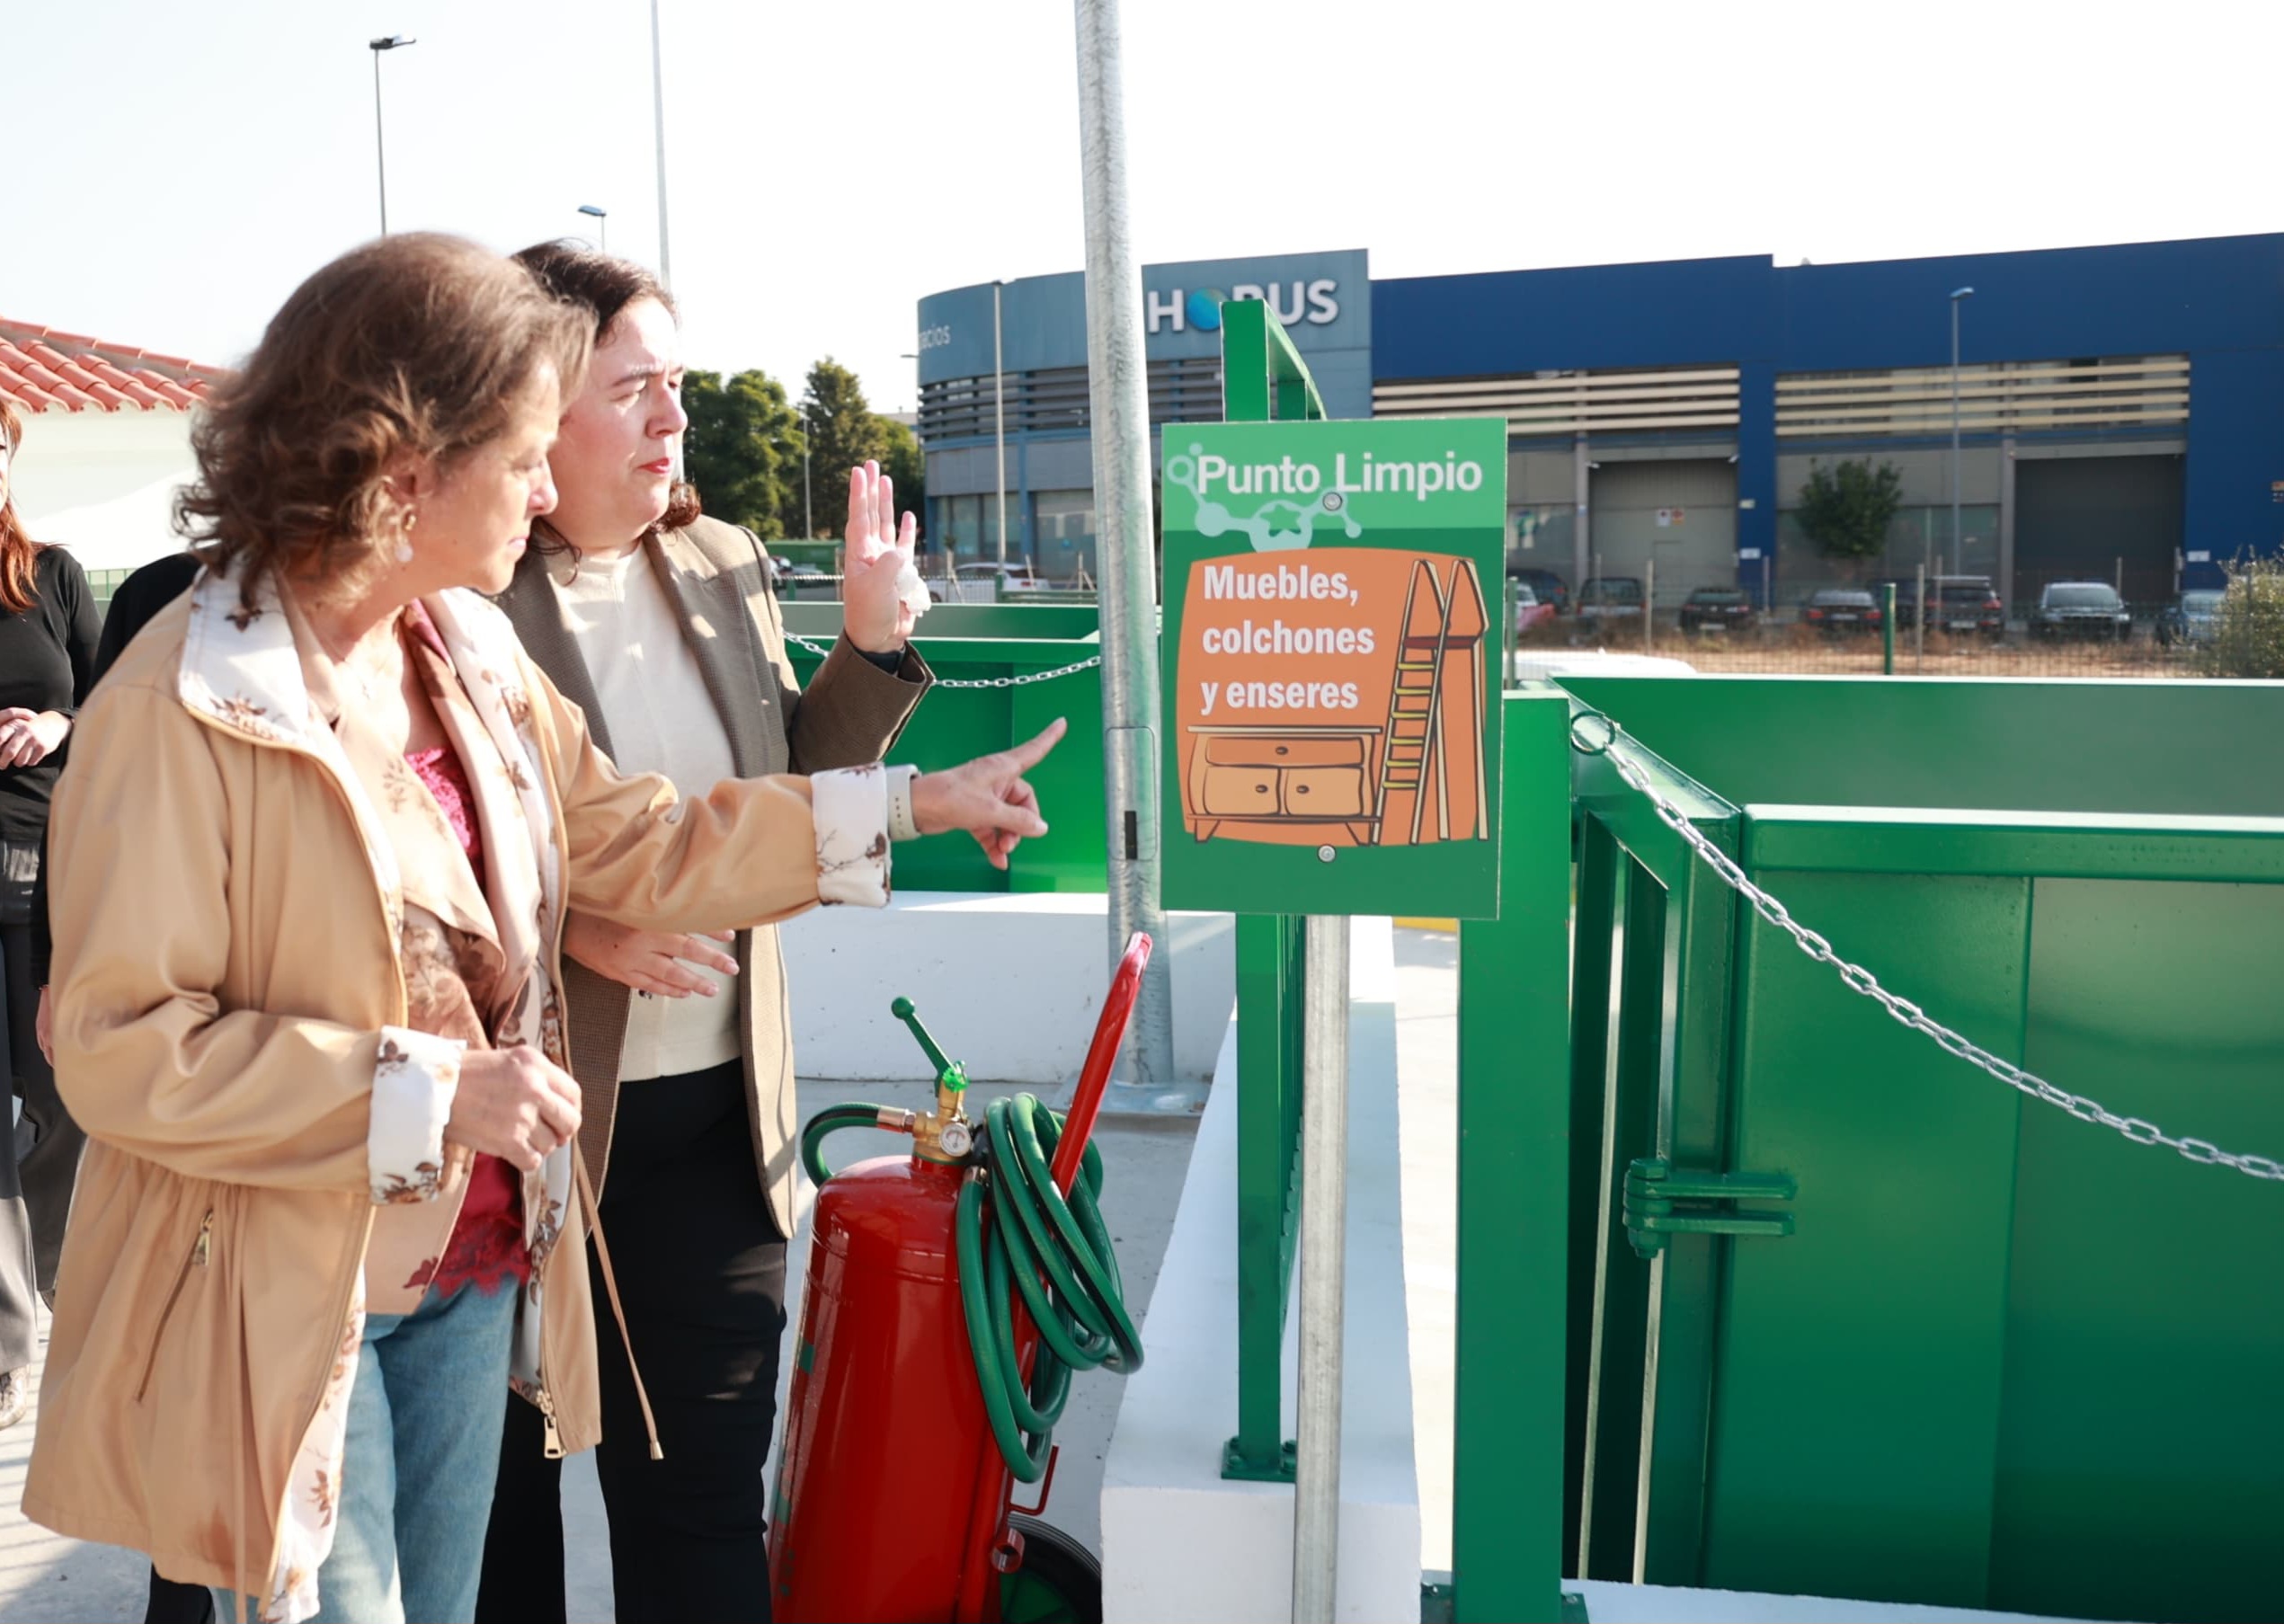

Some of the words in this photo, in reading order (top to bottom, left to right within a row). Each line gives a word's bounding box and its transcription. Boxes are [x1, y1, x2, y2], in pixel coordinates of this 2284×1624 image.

[1195, 455, 1320, 494] Punto
[1336, 453, 1482, 501] Limpio
[1204, 565, 1358, 606] Muebles,
[1203, 621, 1375, 654] colchones
[1201, 682, 1218, 715] y
[1226, 680, 1359, 709] enseres
